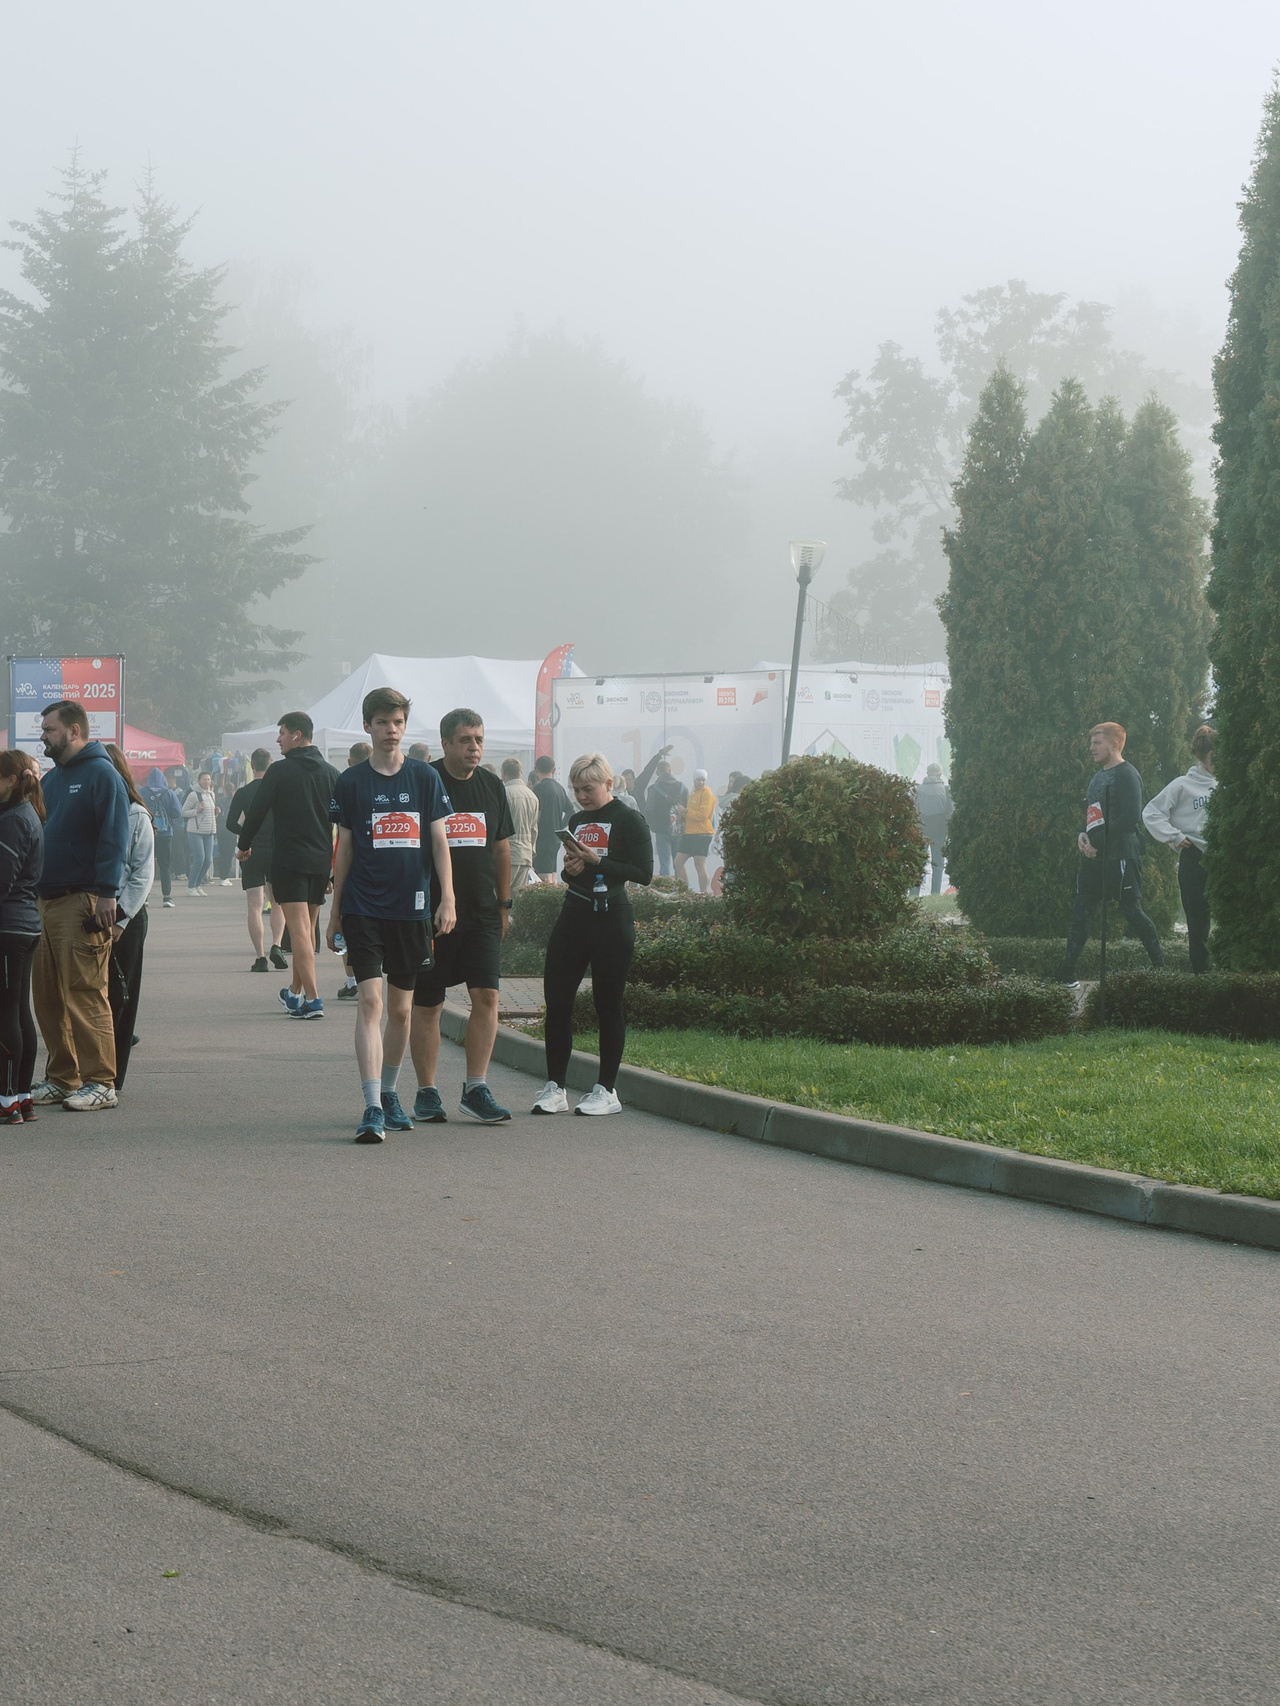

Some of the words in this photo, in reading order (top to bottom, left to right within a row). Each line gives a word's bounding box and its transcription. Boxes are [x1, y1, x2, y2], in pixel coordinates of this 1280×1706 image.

[42, 690, 80, 699] СОБЫТИЙ
[83, 683, 116, 699] 2025
[1193, 796, 1207, 810] GO
[384, 822, 410, 833] 2229
[452, 822, 477, 833] 2250
[580, 832, 599, 842] 2108
